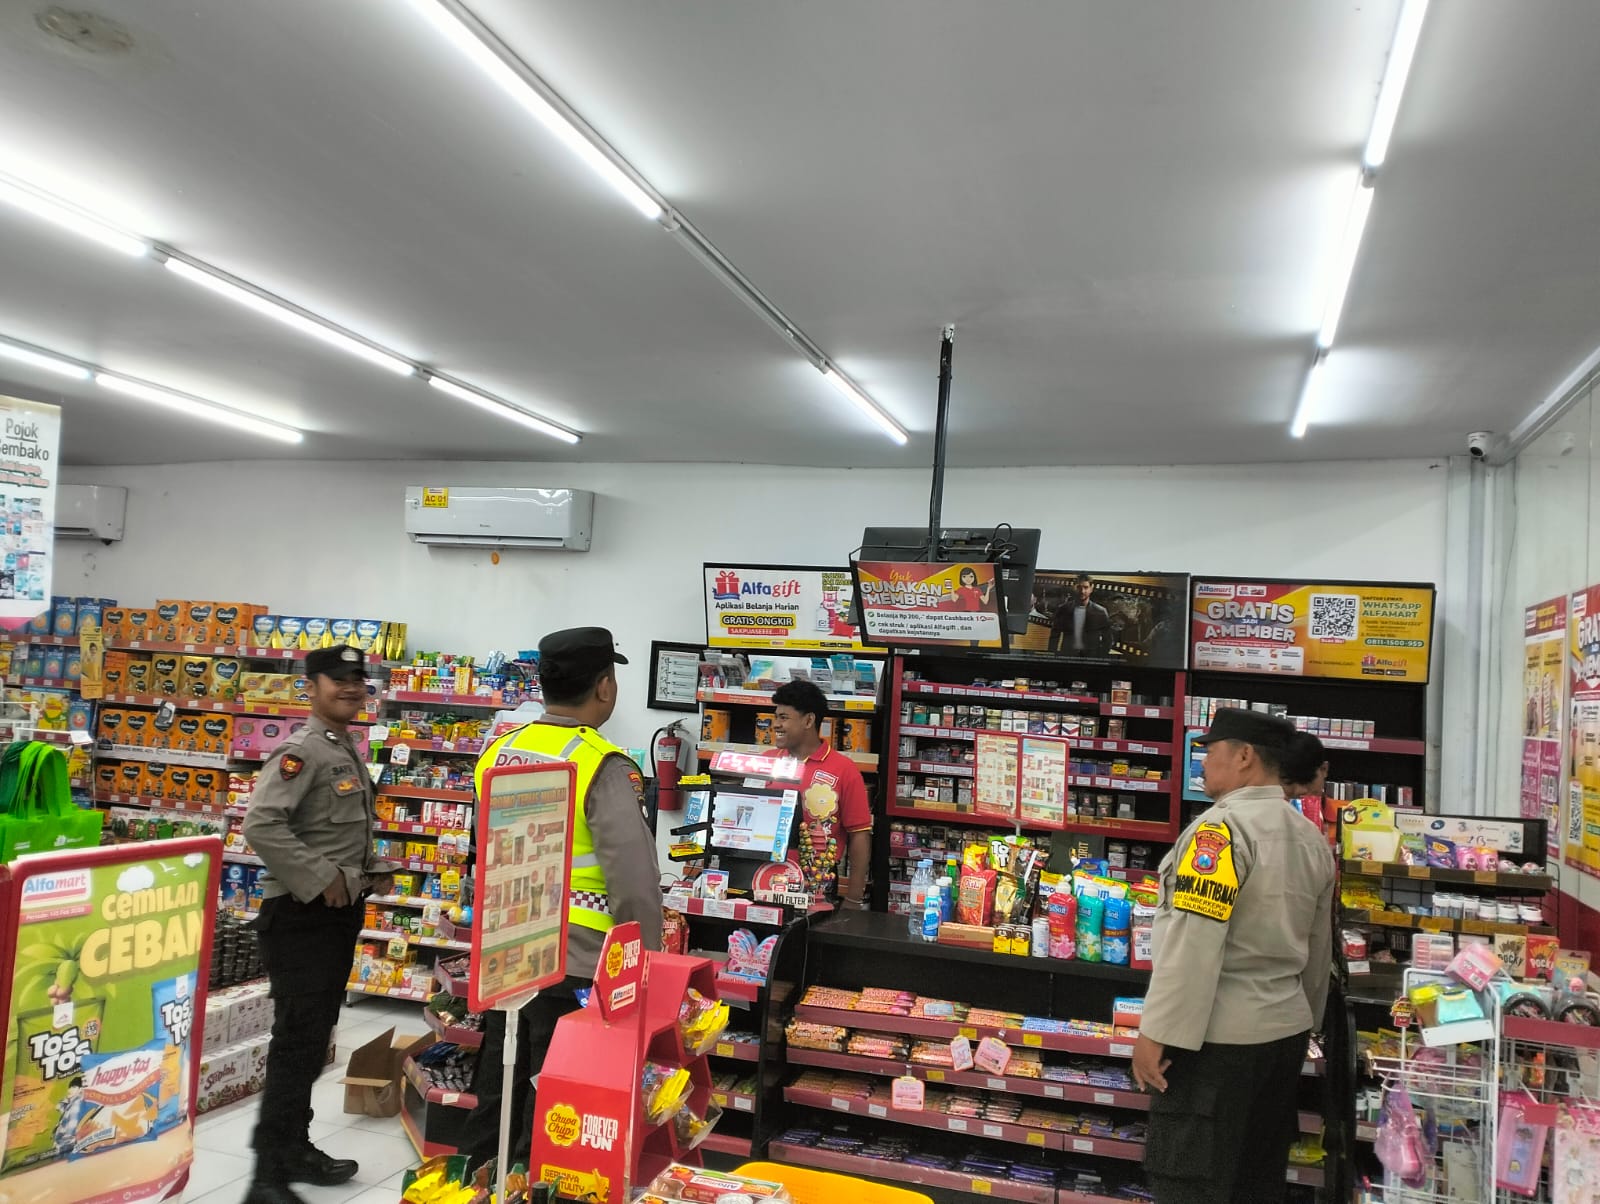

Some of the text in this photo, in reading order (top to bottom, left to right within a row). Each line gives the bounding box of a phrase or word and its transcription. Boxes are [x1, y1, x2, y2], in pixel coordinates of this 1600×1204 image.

[6, 418, 39, 440] Pojok
[425, 495, 436, 503] AC
[741, 579, 801, 598] Alfagift
[860, 581, 943, 597] GUNAKAN
[715, 602, 800, 611] Aplikasi Belanja Harian
[867, 593, 938, 608] MEMBER
[1363, 601, 1422, 610] WHATSAPP
[1208, 601, 1295, 623] GRATIS
[1362, 609, 1419, 619] ALFAMART
[722, 616, 793, 627] GRATIS ONGKIR
[23, 873, 87, 894] Alfamart
[772, 893, 806, 906] NO FILTER
[80, 909, 205, 978] CEBAN
[623, 955, 639, 970] FUN
[29, 1026, 81, 1062] TOS
[547, 1111, 578, 1140] Chupa Chups
[580, 1113, 619, 1152] FOREVER FUN
